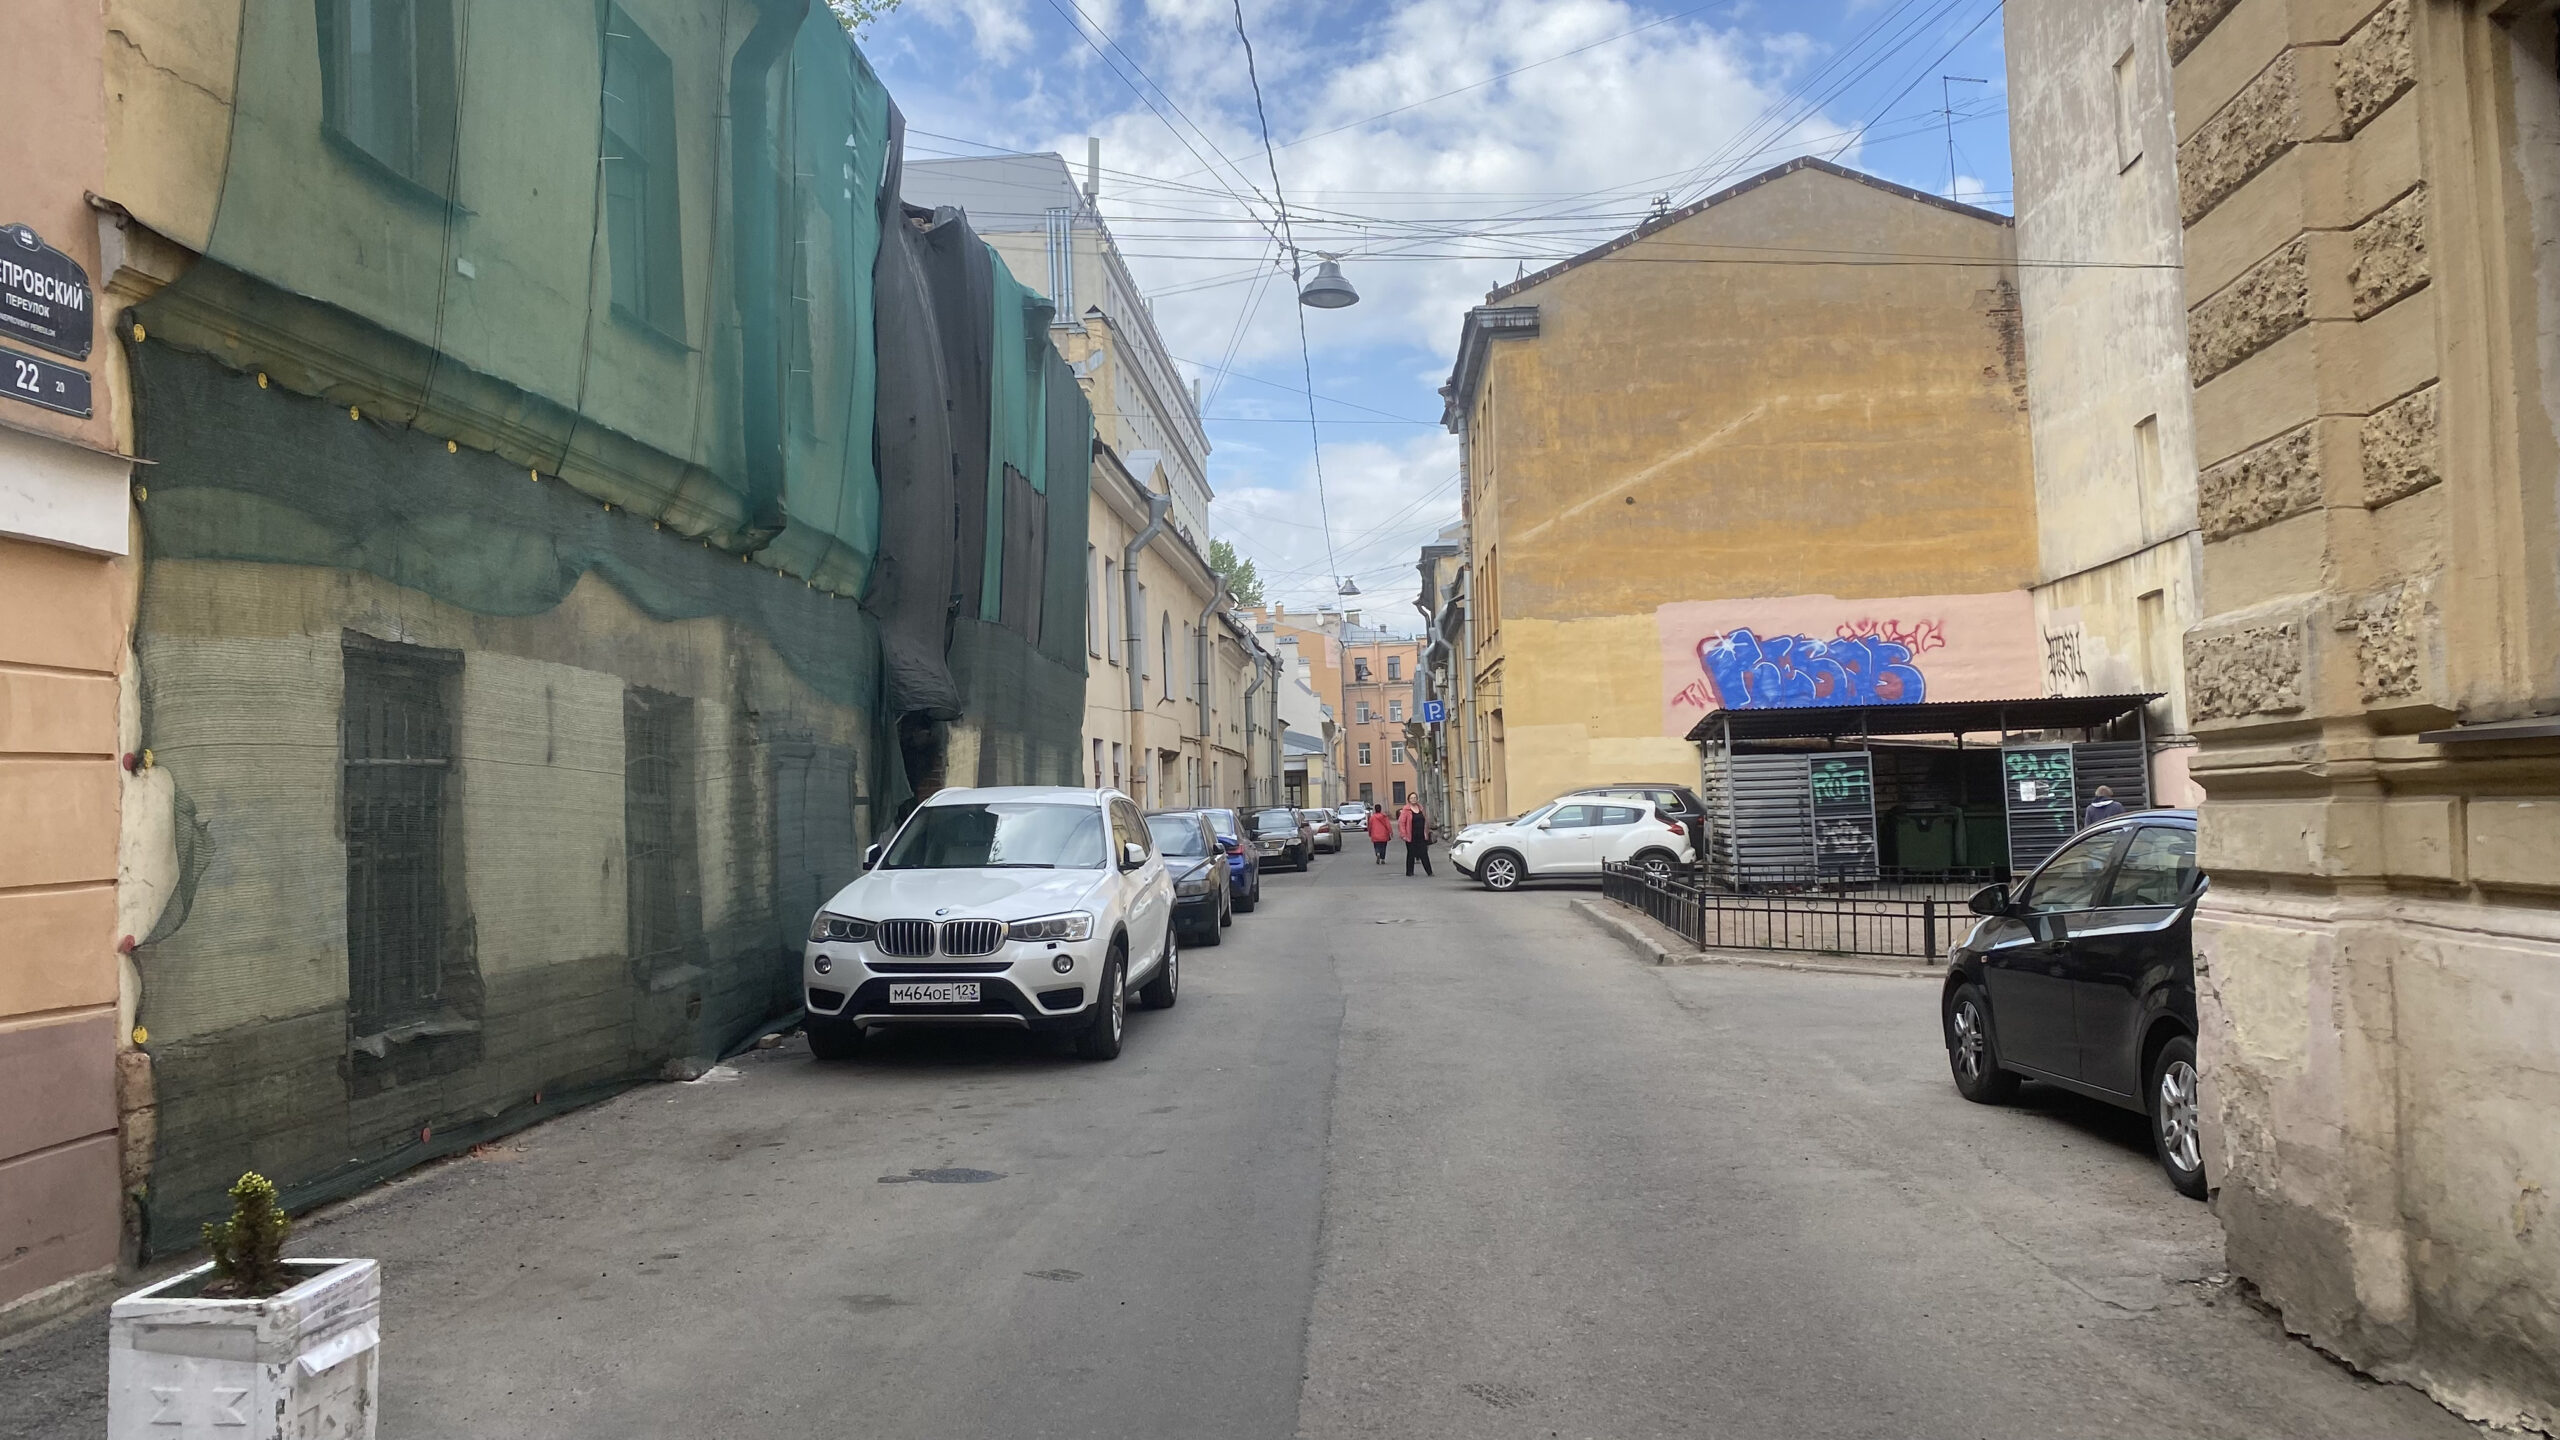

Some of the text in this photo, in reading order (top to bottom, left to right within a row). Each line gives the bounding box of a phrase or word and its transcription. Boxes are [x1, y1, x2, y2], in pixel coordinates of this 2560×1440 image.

[0, 258, 83, 311] ПРОВСКИЙ
[5, 293, 50, 318] ПЕРЕУЛОК
[15, 360, 65, 393] 22 20
[1429, 703, 1441, 720] P
[955, 984, 976, 996] 123
